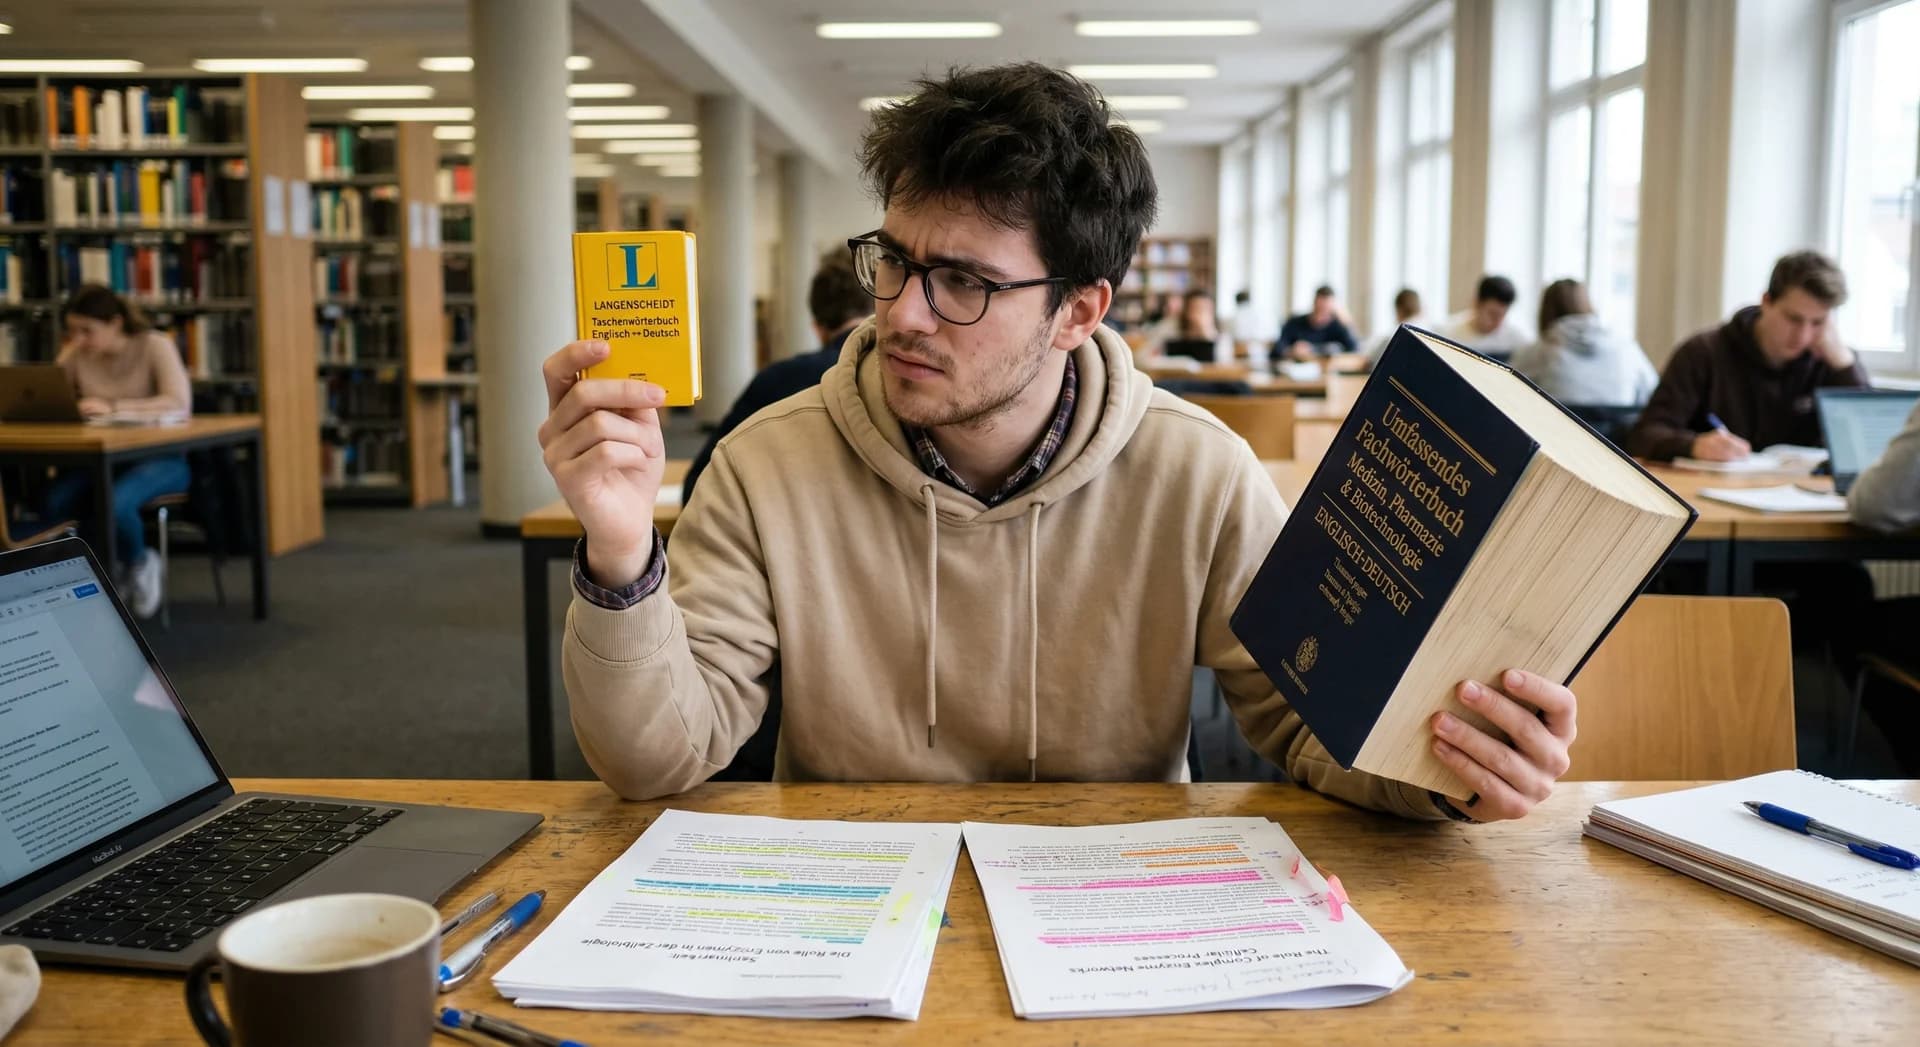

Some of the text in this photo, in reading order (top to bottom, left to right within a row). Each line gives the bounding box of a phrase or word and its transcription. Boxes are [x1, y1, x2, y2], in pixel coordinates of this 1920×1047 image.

[619, 245, 656, 288] L
[594, 299, 675, 310] LANGENSCHEIDT
[592, 316, 679, 327] Taschenwörterbuch
[592, 328, 680, 341] Englisch Deutsch
[1382, 401, 1471, 497] Umfassendes
[1355, 419, 1465, 537] Fachwörterbuch
[1346, 452, 1445, 558] Medizin, Pharmazie
[1340, 479, 1423, 571] & Biotechnologie
[1314, 506, 1412, 616] ENGLISCH-DEUTSCH
[656, 943, 678, 951] der
[793, 950, 826, 958] Rolle
[1134, 953, 1200, 961] Processes
[1069, 948, 1328, 974] The Role of Complex Enzyme Networks
